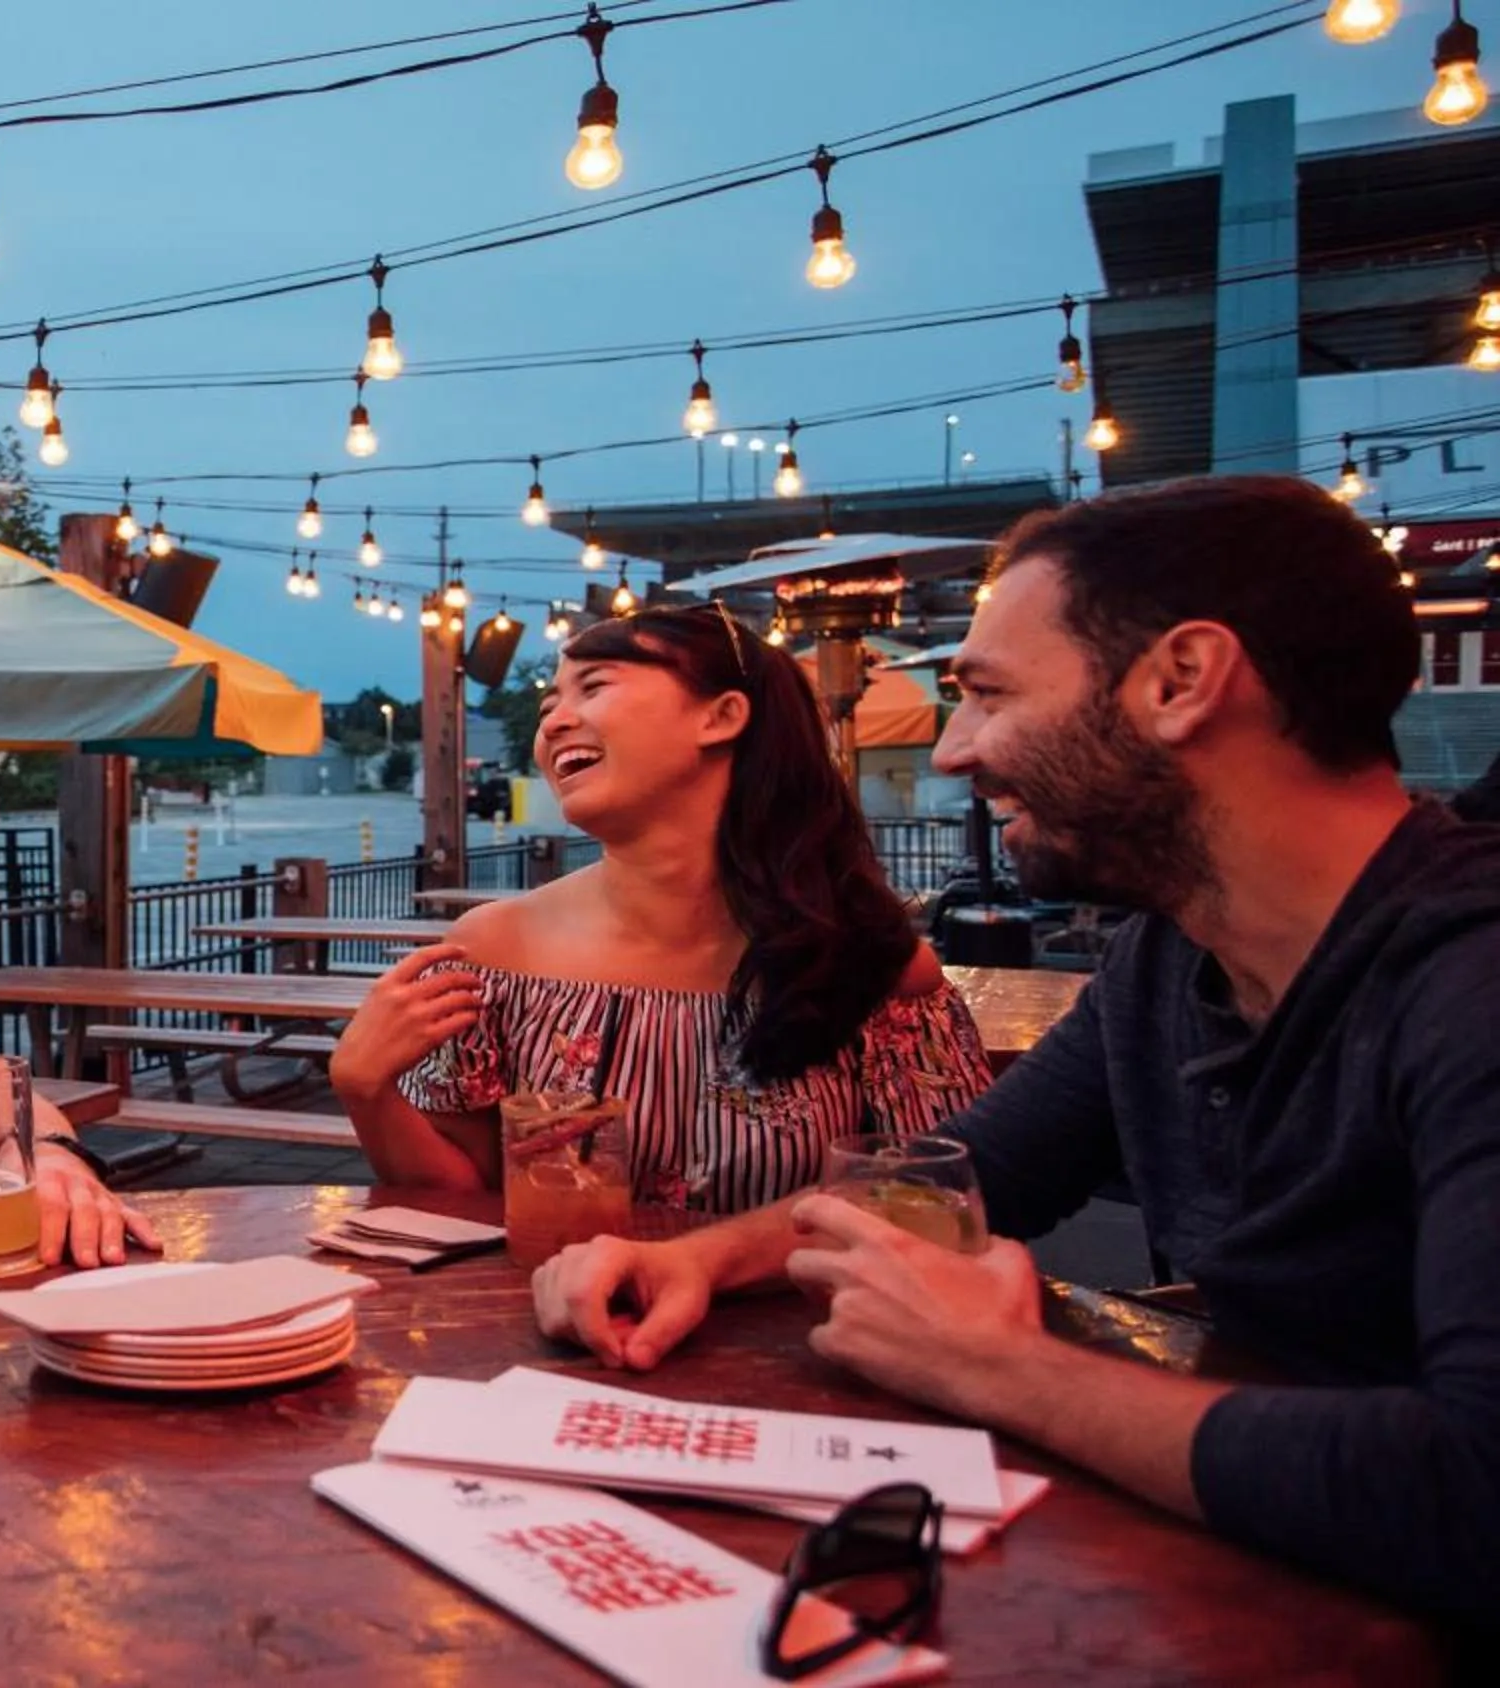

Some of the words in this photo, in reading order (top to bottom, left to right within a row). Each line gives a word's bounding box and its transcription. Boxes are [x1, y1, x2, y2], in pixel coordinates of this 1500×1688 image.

[487, 1519, 628, 1554] YOU
[545, 1543, 658, 1583] ARE
[566, 1565, 738, 1614] HERE
